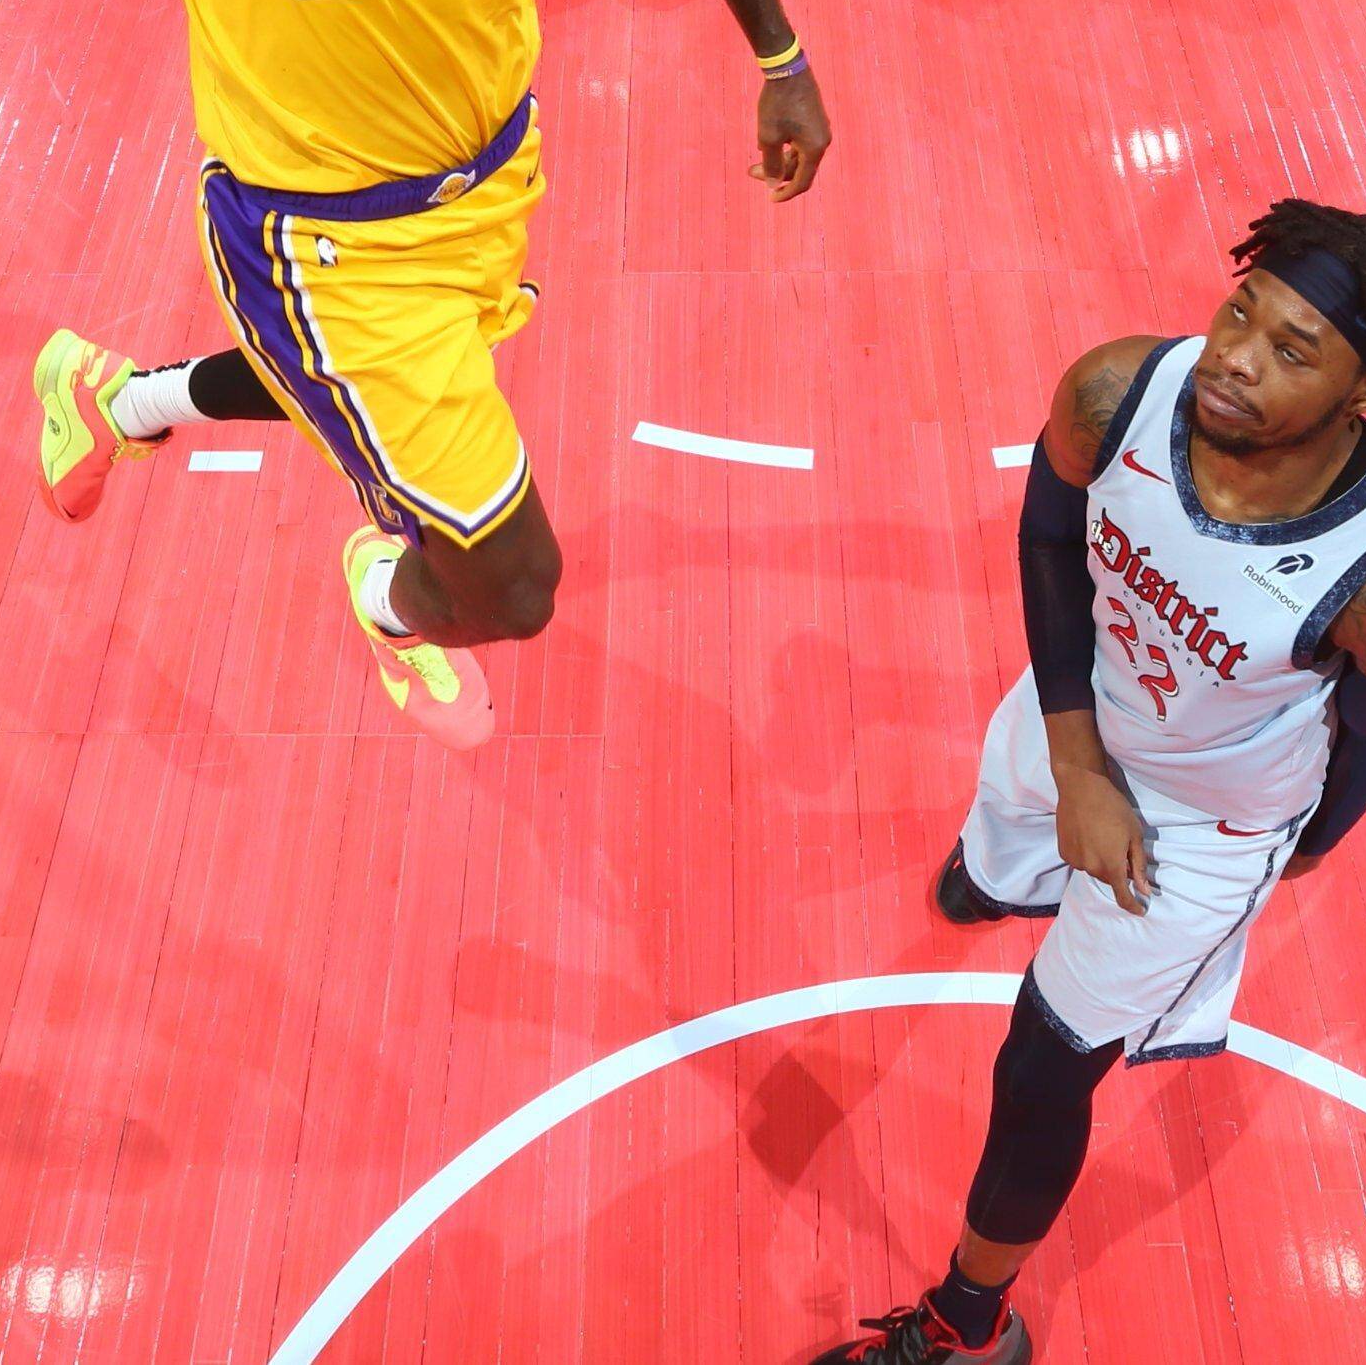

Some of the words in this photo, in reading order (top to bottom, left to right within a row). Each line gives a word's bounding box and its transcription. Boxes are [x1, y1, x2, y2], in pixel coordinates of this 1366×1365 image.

[1090, 506, 1248, 681] District
[1243, 563, 1304, 615] Robinhood
[1106, 595, 1180, 723] 22
